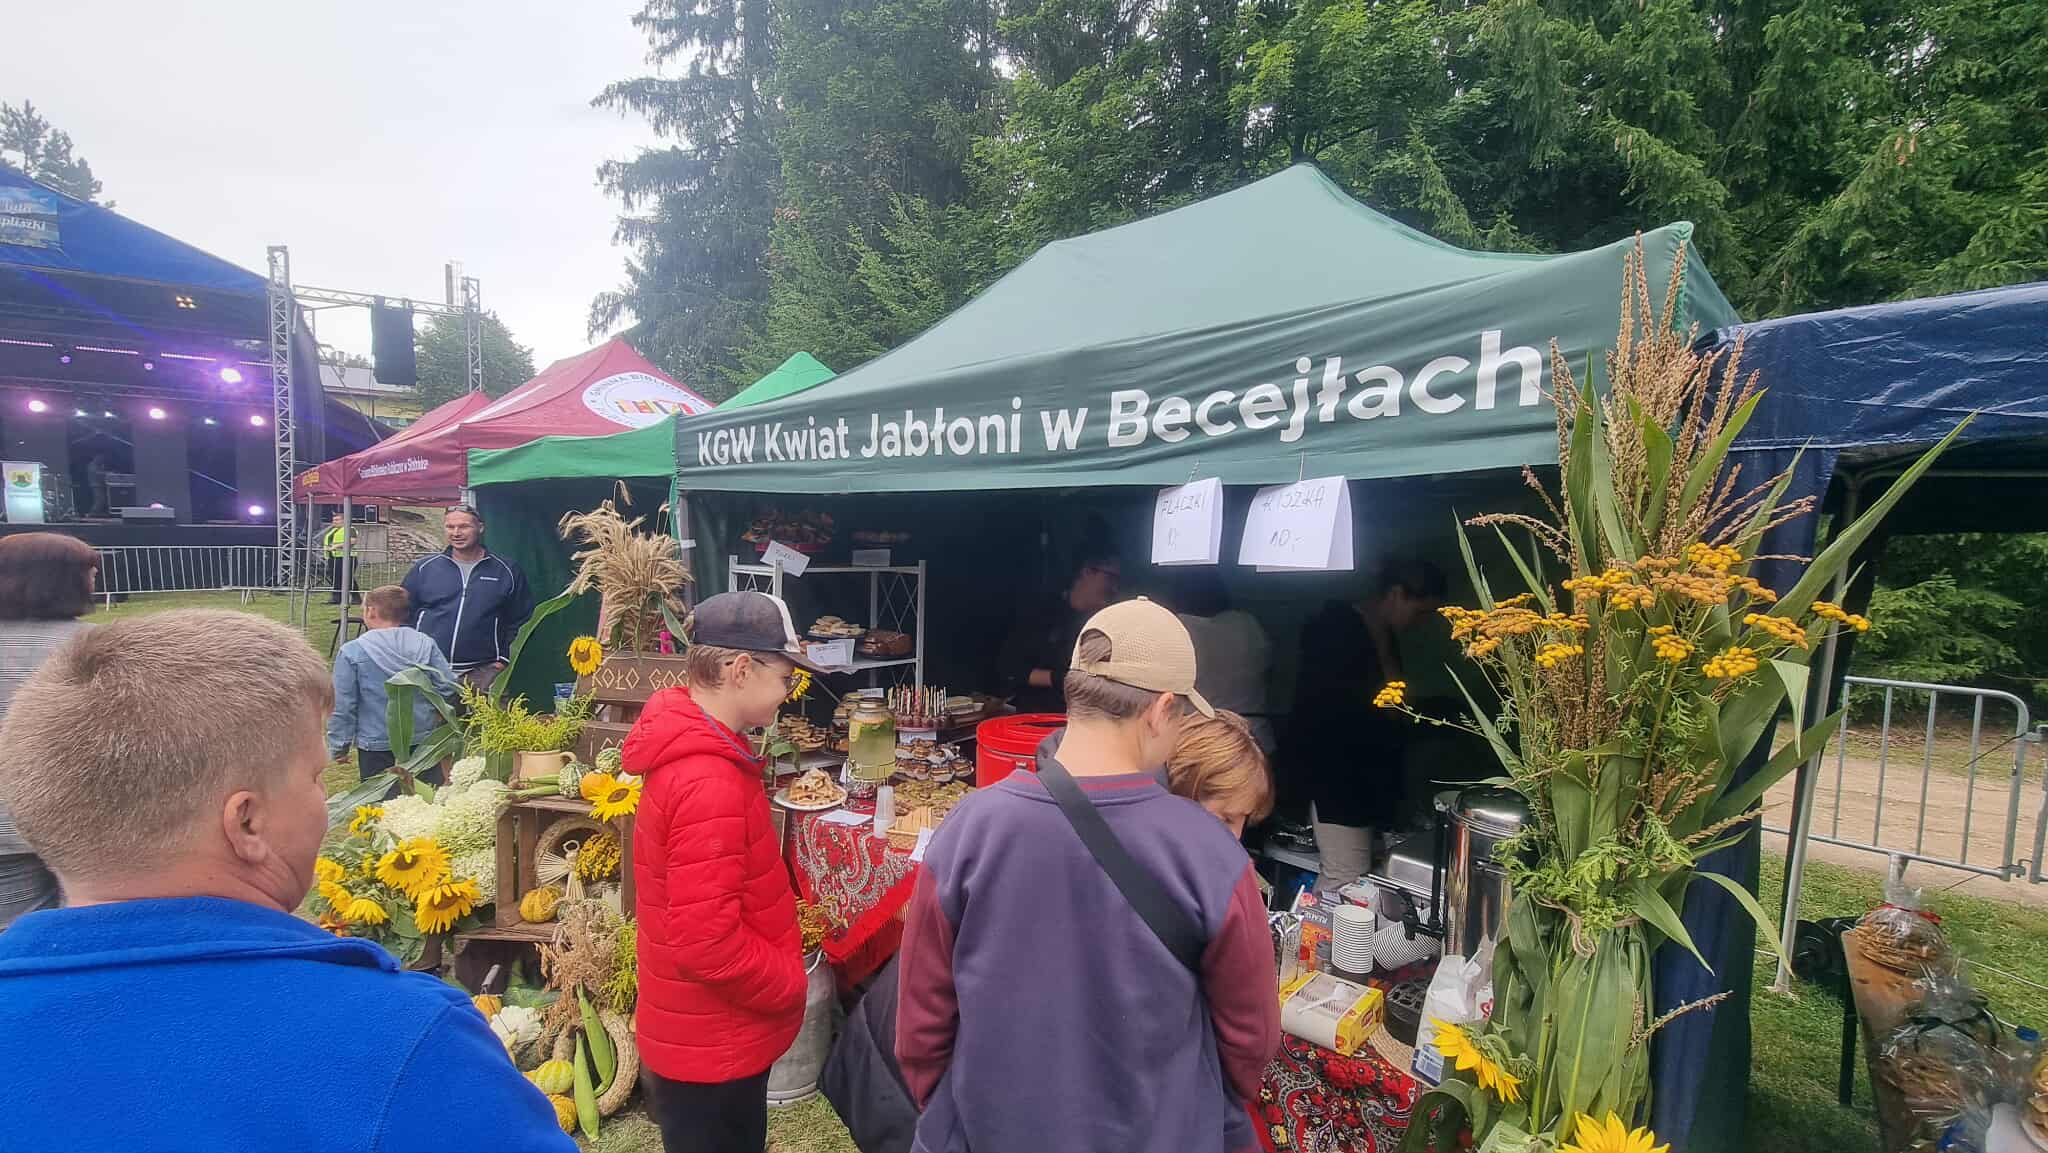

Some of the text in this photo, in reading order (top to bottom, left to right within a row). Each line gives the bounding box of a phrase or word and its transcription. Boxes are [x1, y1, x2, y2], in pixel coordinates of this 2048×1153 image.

[698, 329, 1544, 466] KGW Kwiat Jabłoni w Becejłach
[592, 667, 690, 691] KOŁO GOS
